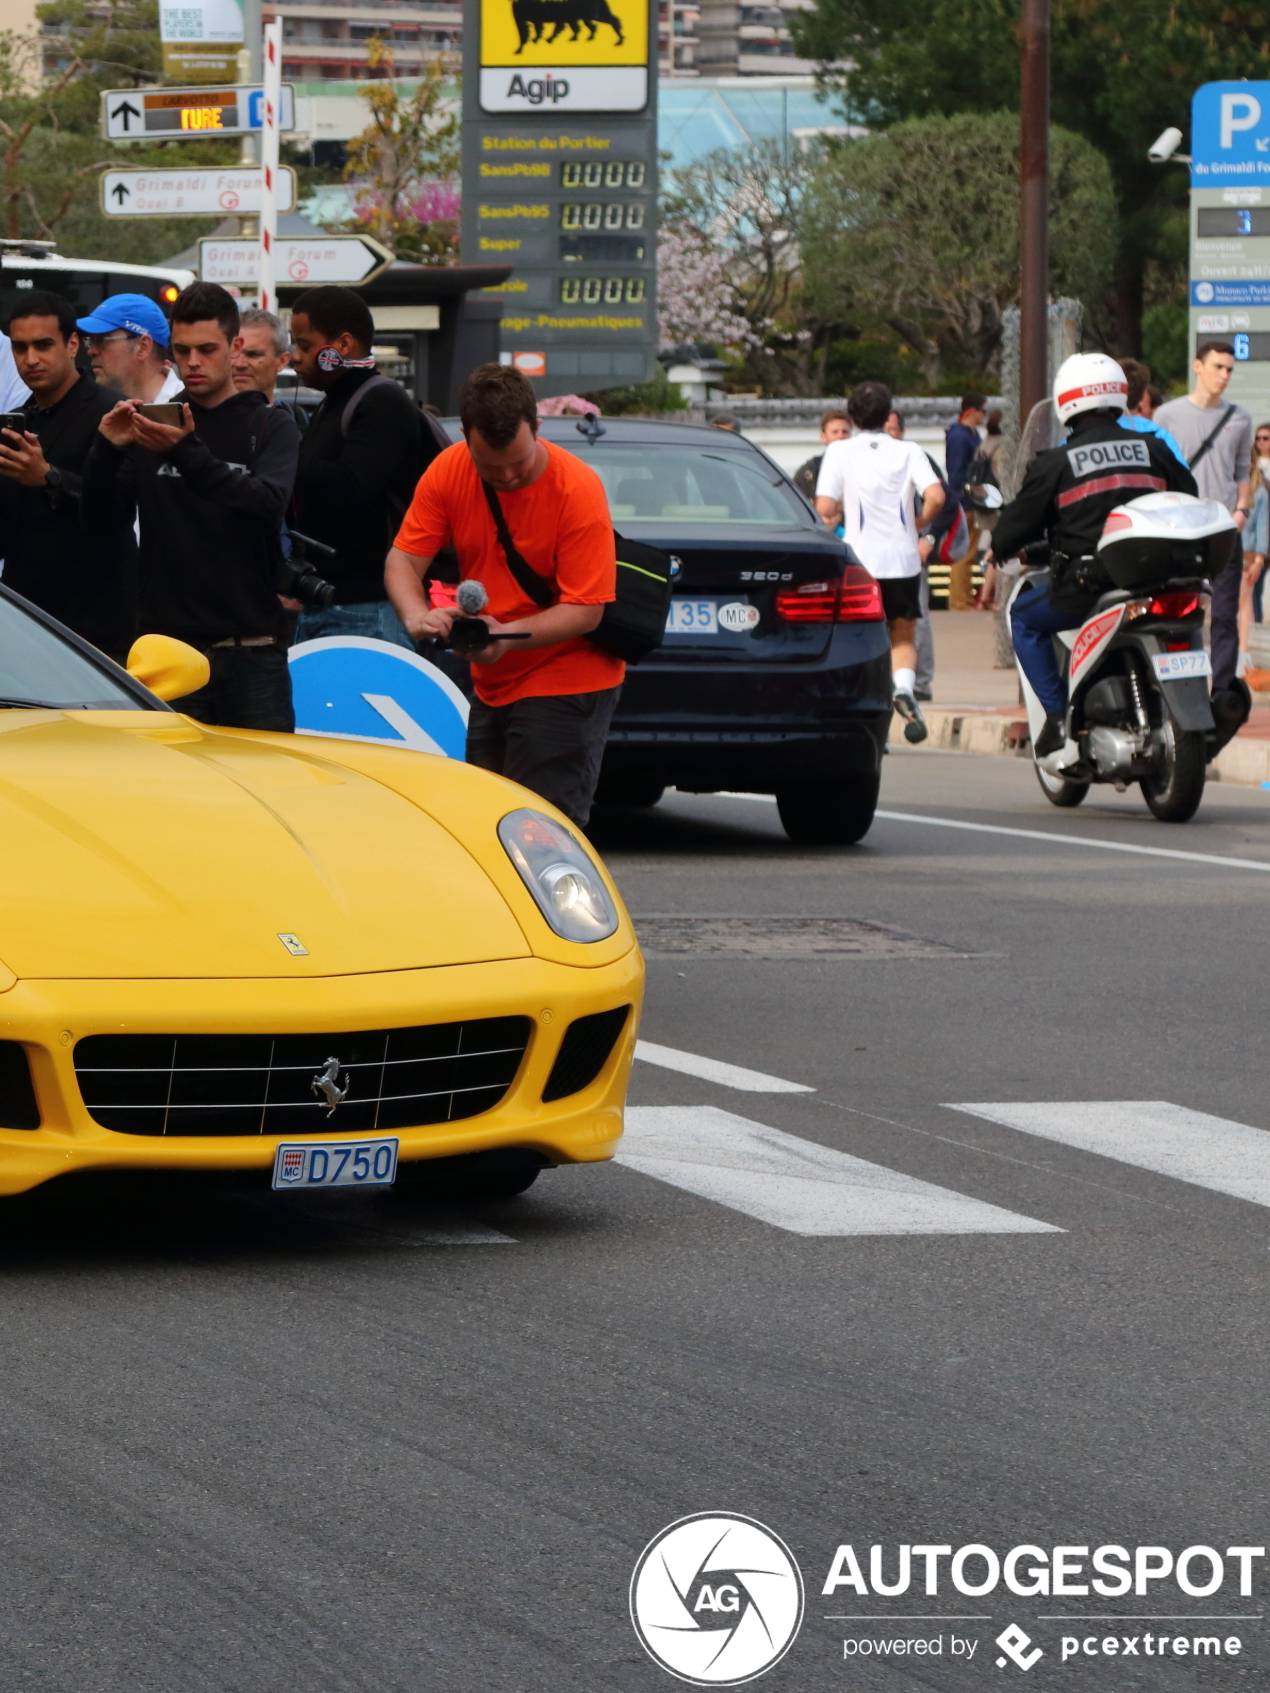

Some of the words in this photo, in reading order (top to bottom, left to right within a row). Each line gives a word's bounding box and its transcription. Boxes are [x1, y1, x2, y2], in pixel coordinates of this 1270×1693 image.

[164, 9, 179, 19] THE
[182, 9, 203, 19] BEST
[165, 29, 179, 38] THE
[507, 74, 570, 104] Agip
[1220, 93, 1262, 149] P
[482, 136, 536, 150] Station
[538, 136, 557, 149] du
[559, 135, 611, 149] Portier
[1195, 162, 1209, 174] du
[1211, 161, 1255, 174] Grimaldi
[136, 177, 207, 192] Grimaldi
[136, 198, 168, 210] Quai
[480, 237, 522, 251] Super
[208, 247, 261, 262] Grimal
[287, 247, 336, 260] Forum
[208, 266, 239, 278] Quai
[1201, 265, 1237, 277] Ouvert
[1215, 285, 1249, 296] Monaco
[125, 320, 150, 336] VRS
[1233, 333, 1250, 360] 6
[1081, 383, 1122, 397] POLICE
[1073, 444, 1146, 472] POLICE
[726, 609, 747, 624] MC
[1072, 624, 1101, 670] POLICE
[1171, 655, 1207, 671] SP77
[284, 1166, 300, 1178] MC
[308, 1145, 392, 1184] D750
